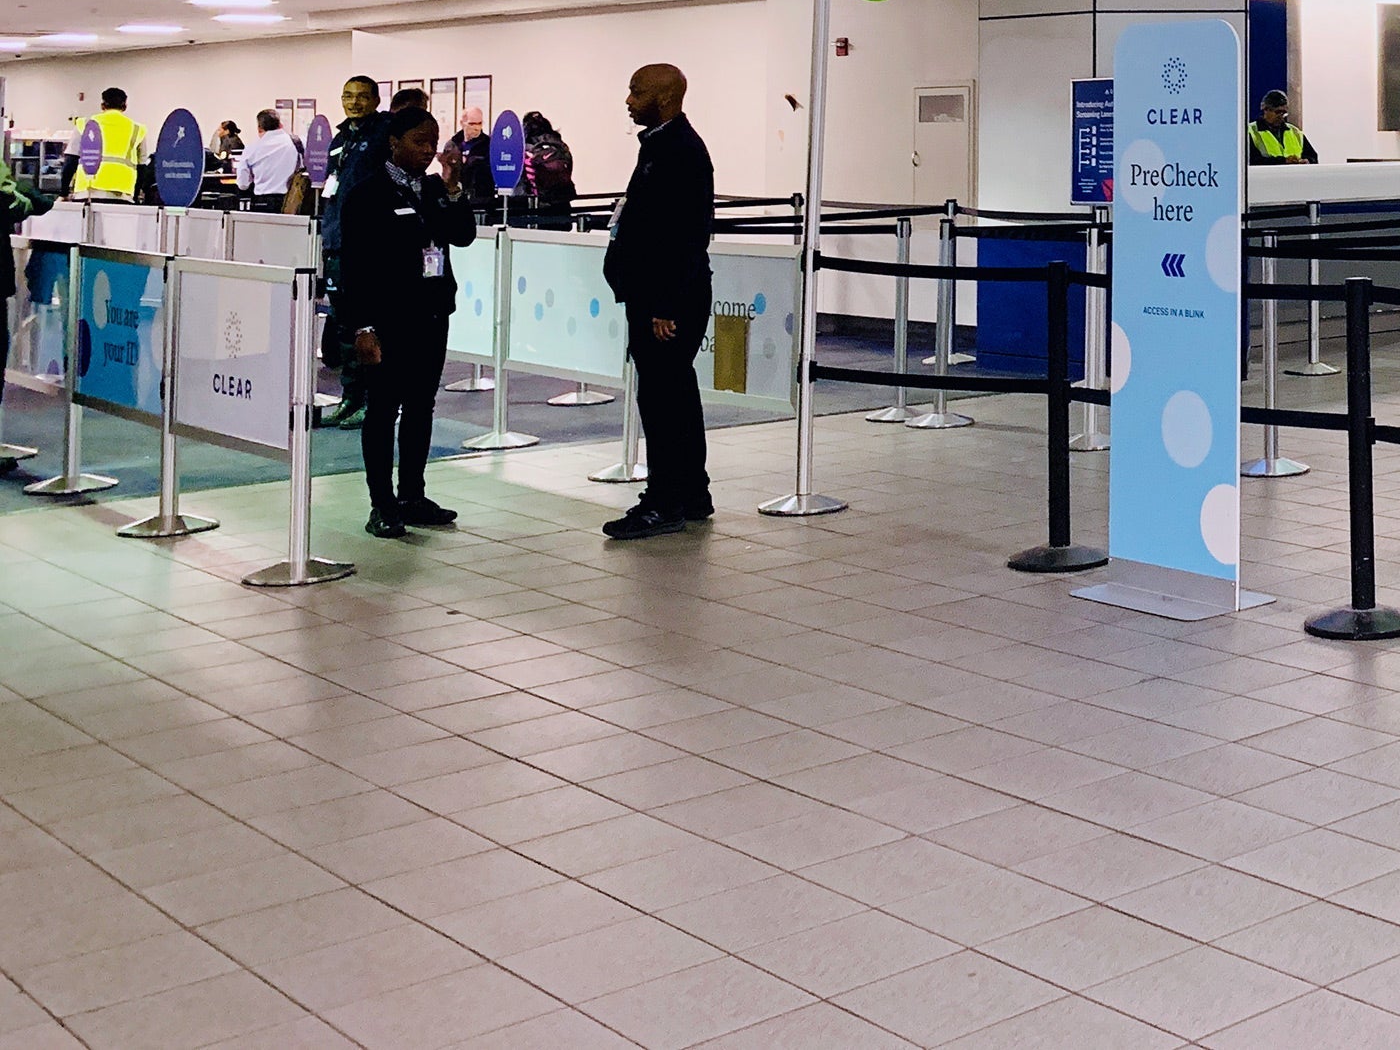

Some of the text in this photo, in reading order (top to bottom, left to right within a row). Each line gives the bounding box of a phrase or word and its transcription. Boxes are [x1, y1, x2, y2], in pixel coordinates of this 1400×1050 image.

[1146, 108, 1203, 126] CLEAR
[1130, 162, 1219, 188] PreCheck
[1152, 196, 1194, 222] here
[105, 299, 140, 329] You are
[1142, 305, 1205, 319] ACCESS IN A BLINK
[103, 341, 125, 368] your
[213, 373, 252, 400] CLEAR
